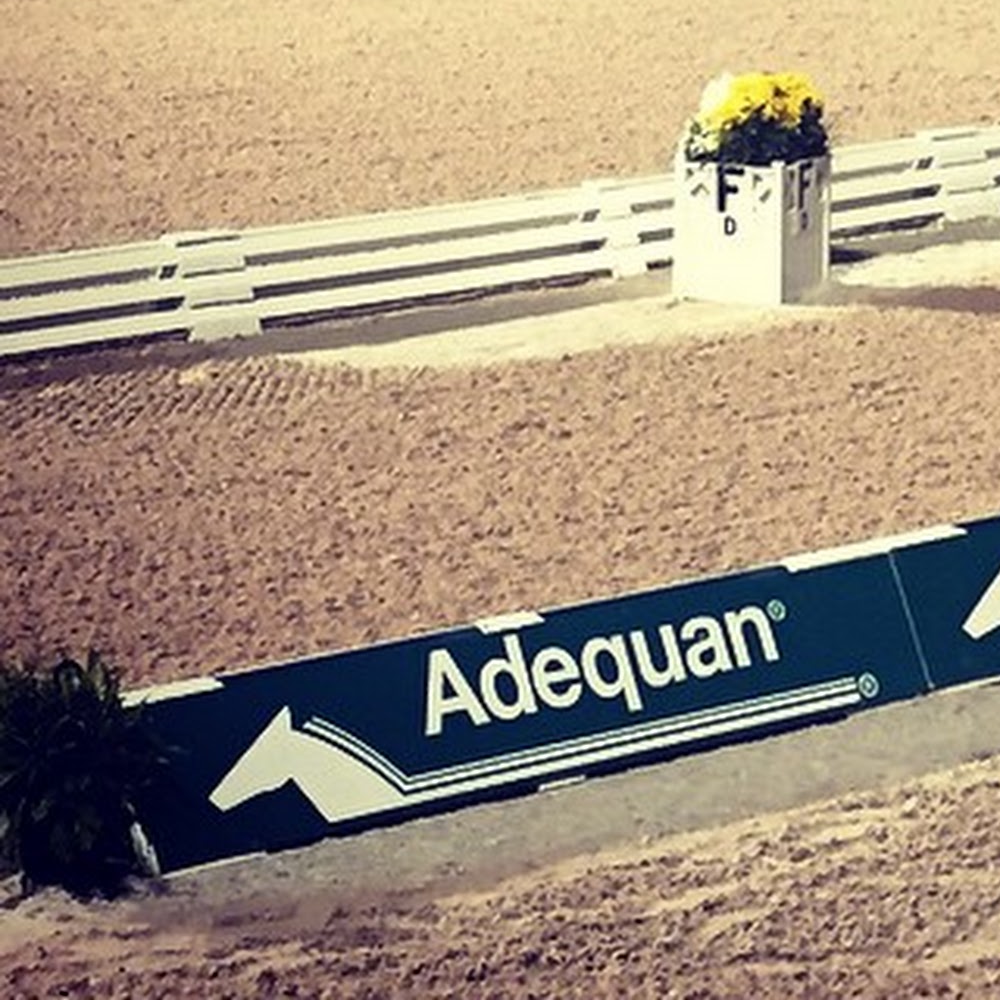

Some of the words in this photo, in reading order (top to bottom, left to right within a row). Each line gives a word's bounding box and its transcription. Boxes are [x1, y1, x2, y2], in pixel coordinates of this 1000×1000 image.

[717, 165, 745, 212] F
[724, 216, 737, 235] D
[423, 605, 780, 736] Adequan
